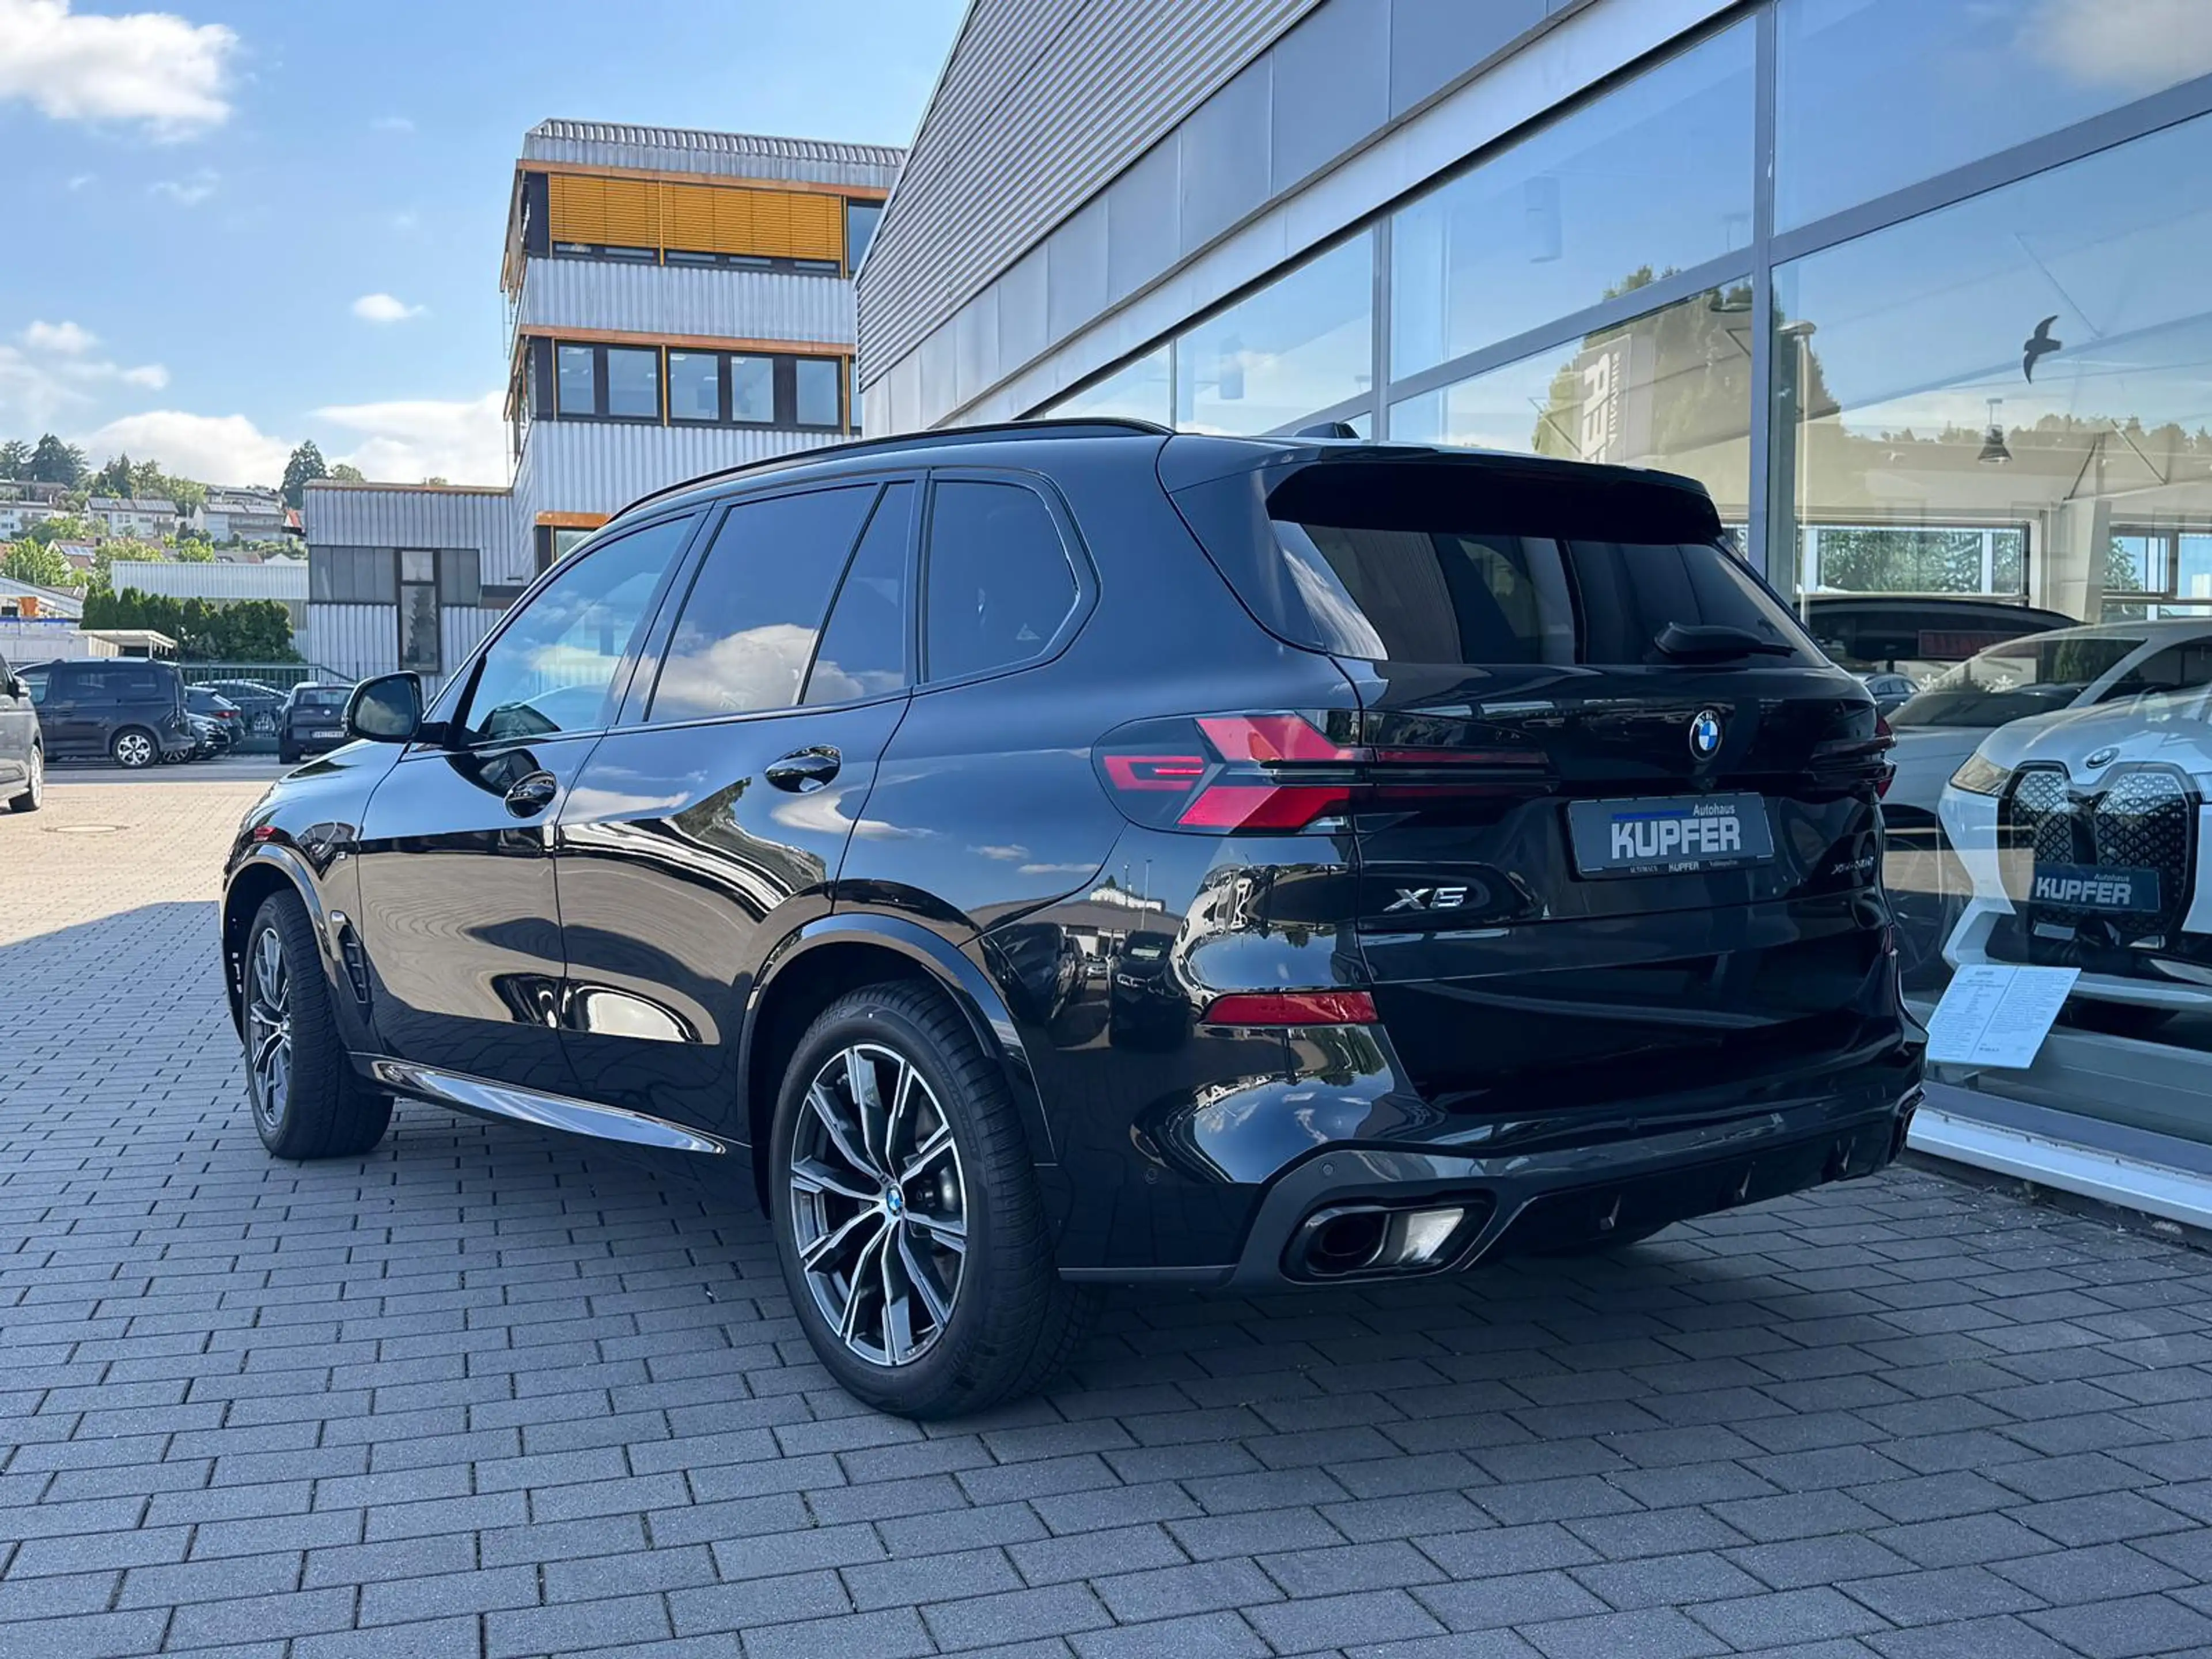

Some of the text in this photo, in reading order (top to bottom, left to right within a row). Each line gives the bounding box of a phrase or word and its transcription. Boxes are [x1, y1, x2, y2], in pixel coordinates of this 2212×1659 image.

[1692, 802, 1736, 817] Autohaus
[1611, 817, 1740, 859] KUPFER
[1382, 887, 1468, 912] X5
[2036, 876, 2132, 905] KUPFER
